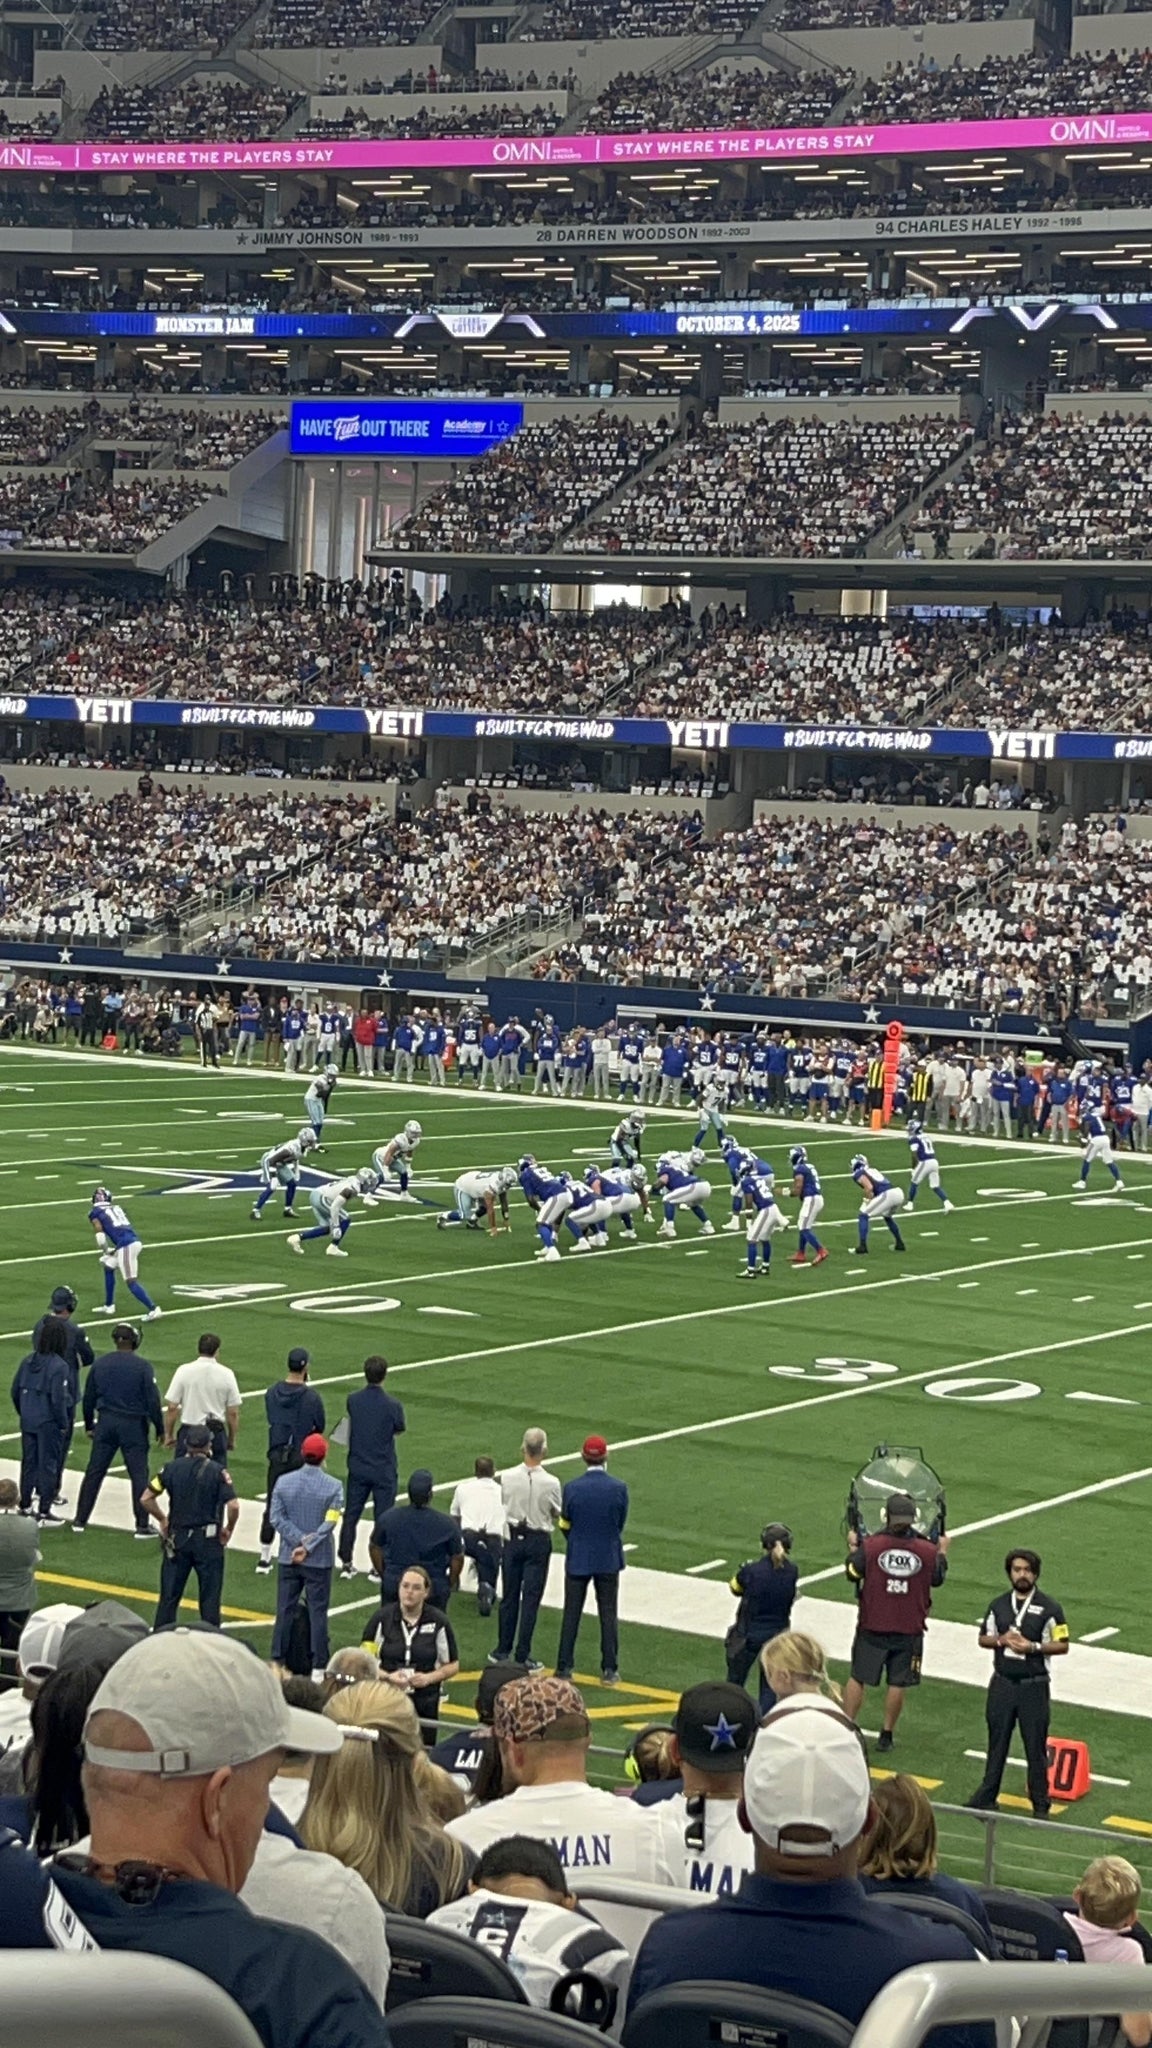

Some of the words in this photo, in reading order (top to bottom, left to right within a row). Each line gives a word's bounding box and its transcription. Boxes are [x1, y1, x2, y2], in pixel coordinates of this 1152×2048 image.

[1050, 119, 1115, 141] OMNI
[493, 141, 551, 161] OMNI
[613, 142, 653, 156] STAY
[657, 140, 714, 154] WHERE
[718, 139, 751, 152] THE
[754, 136, 829, 151] PLAYERS
[833, 134, 875, 148] STAY
[92, 152, 129, 165] STAY
[133, 152, 186, 164] WHERE
[189, 151, 219, 164] THE
[223, 151, 292, 163] PLAYERS
[295, 149, 334, 162] STAY
[536, 230, 552, 242] 28
[557, 229, 617, 241] DARREN
[622, 227, 698, 240] WOODSON
[875, 221, 894, 234] 94
[897, 219, 969, 233] CHARLES
[972, 217, 1023, 231] HALEY
[252, 232, 294, 245] JIMMY
[297, 232, 363, 245] JOHNSON
[155, 317, 224, 333] MONSTER
[225, 317, 254, 334] JAM
[676, 316, 745, 332] OCTOBER
[747, 315, 761, 334] 4,
[763, 314, 800, 331] 2025
[300, 418, 332, 436] HAVE
[333, 415, 360, 441] Fun
[361, 420, 386, 437] OUT
[390, 420, 430, 437] THERE
[443, 419, 487, 433] Academy
[74, 699, 133, 723] YETI
[364, 710, 424, 736] YETI
[666, 721, 729, 748] YETI
[987, 731, 1055, 758] YETI
[888, 1554, 911, 1569] FOX
